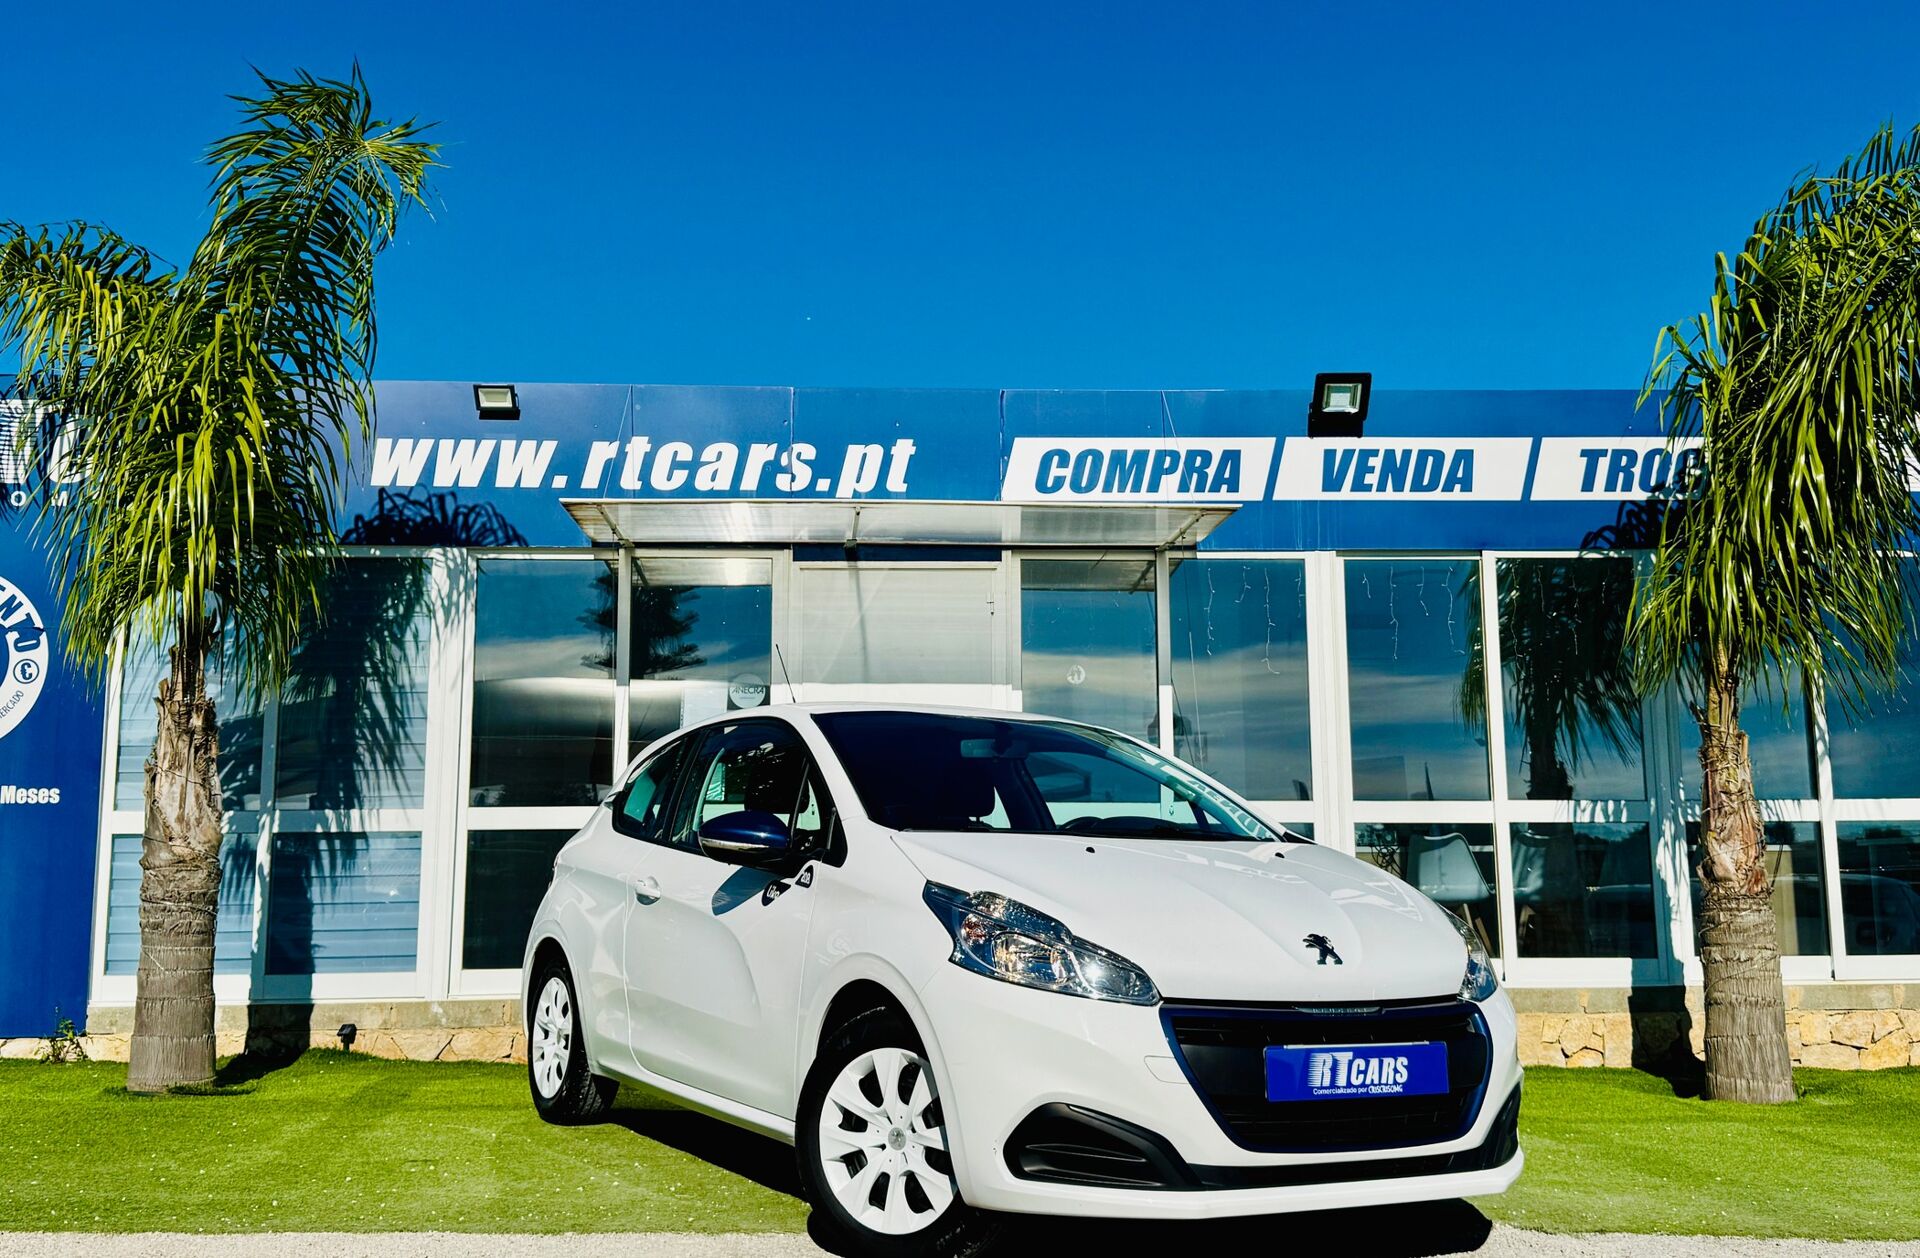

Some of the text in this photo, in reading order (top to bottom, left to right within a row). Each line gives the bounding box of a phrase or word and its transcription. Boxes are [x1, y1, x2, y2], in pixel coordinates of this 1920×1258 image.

[370, 436, 917, 499] www.rtcars.pt
[1034, 448, 1241, 494] COMPRA
[1321, 448, 1474, 493] VENDA
[1579, 448, 1706, 494] TROC
[0, 690, 24, 719] ERCADO
[731, 685, 765, 695] ANECRA
[0, 785, 60, 804] Meses
[1313, 1086, 1357, 1095] Comercializado
